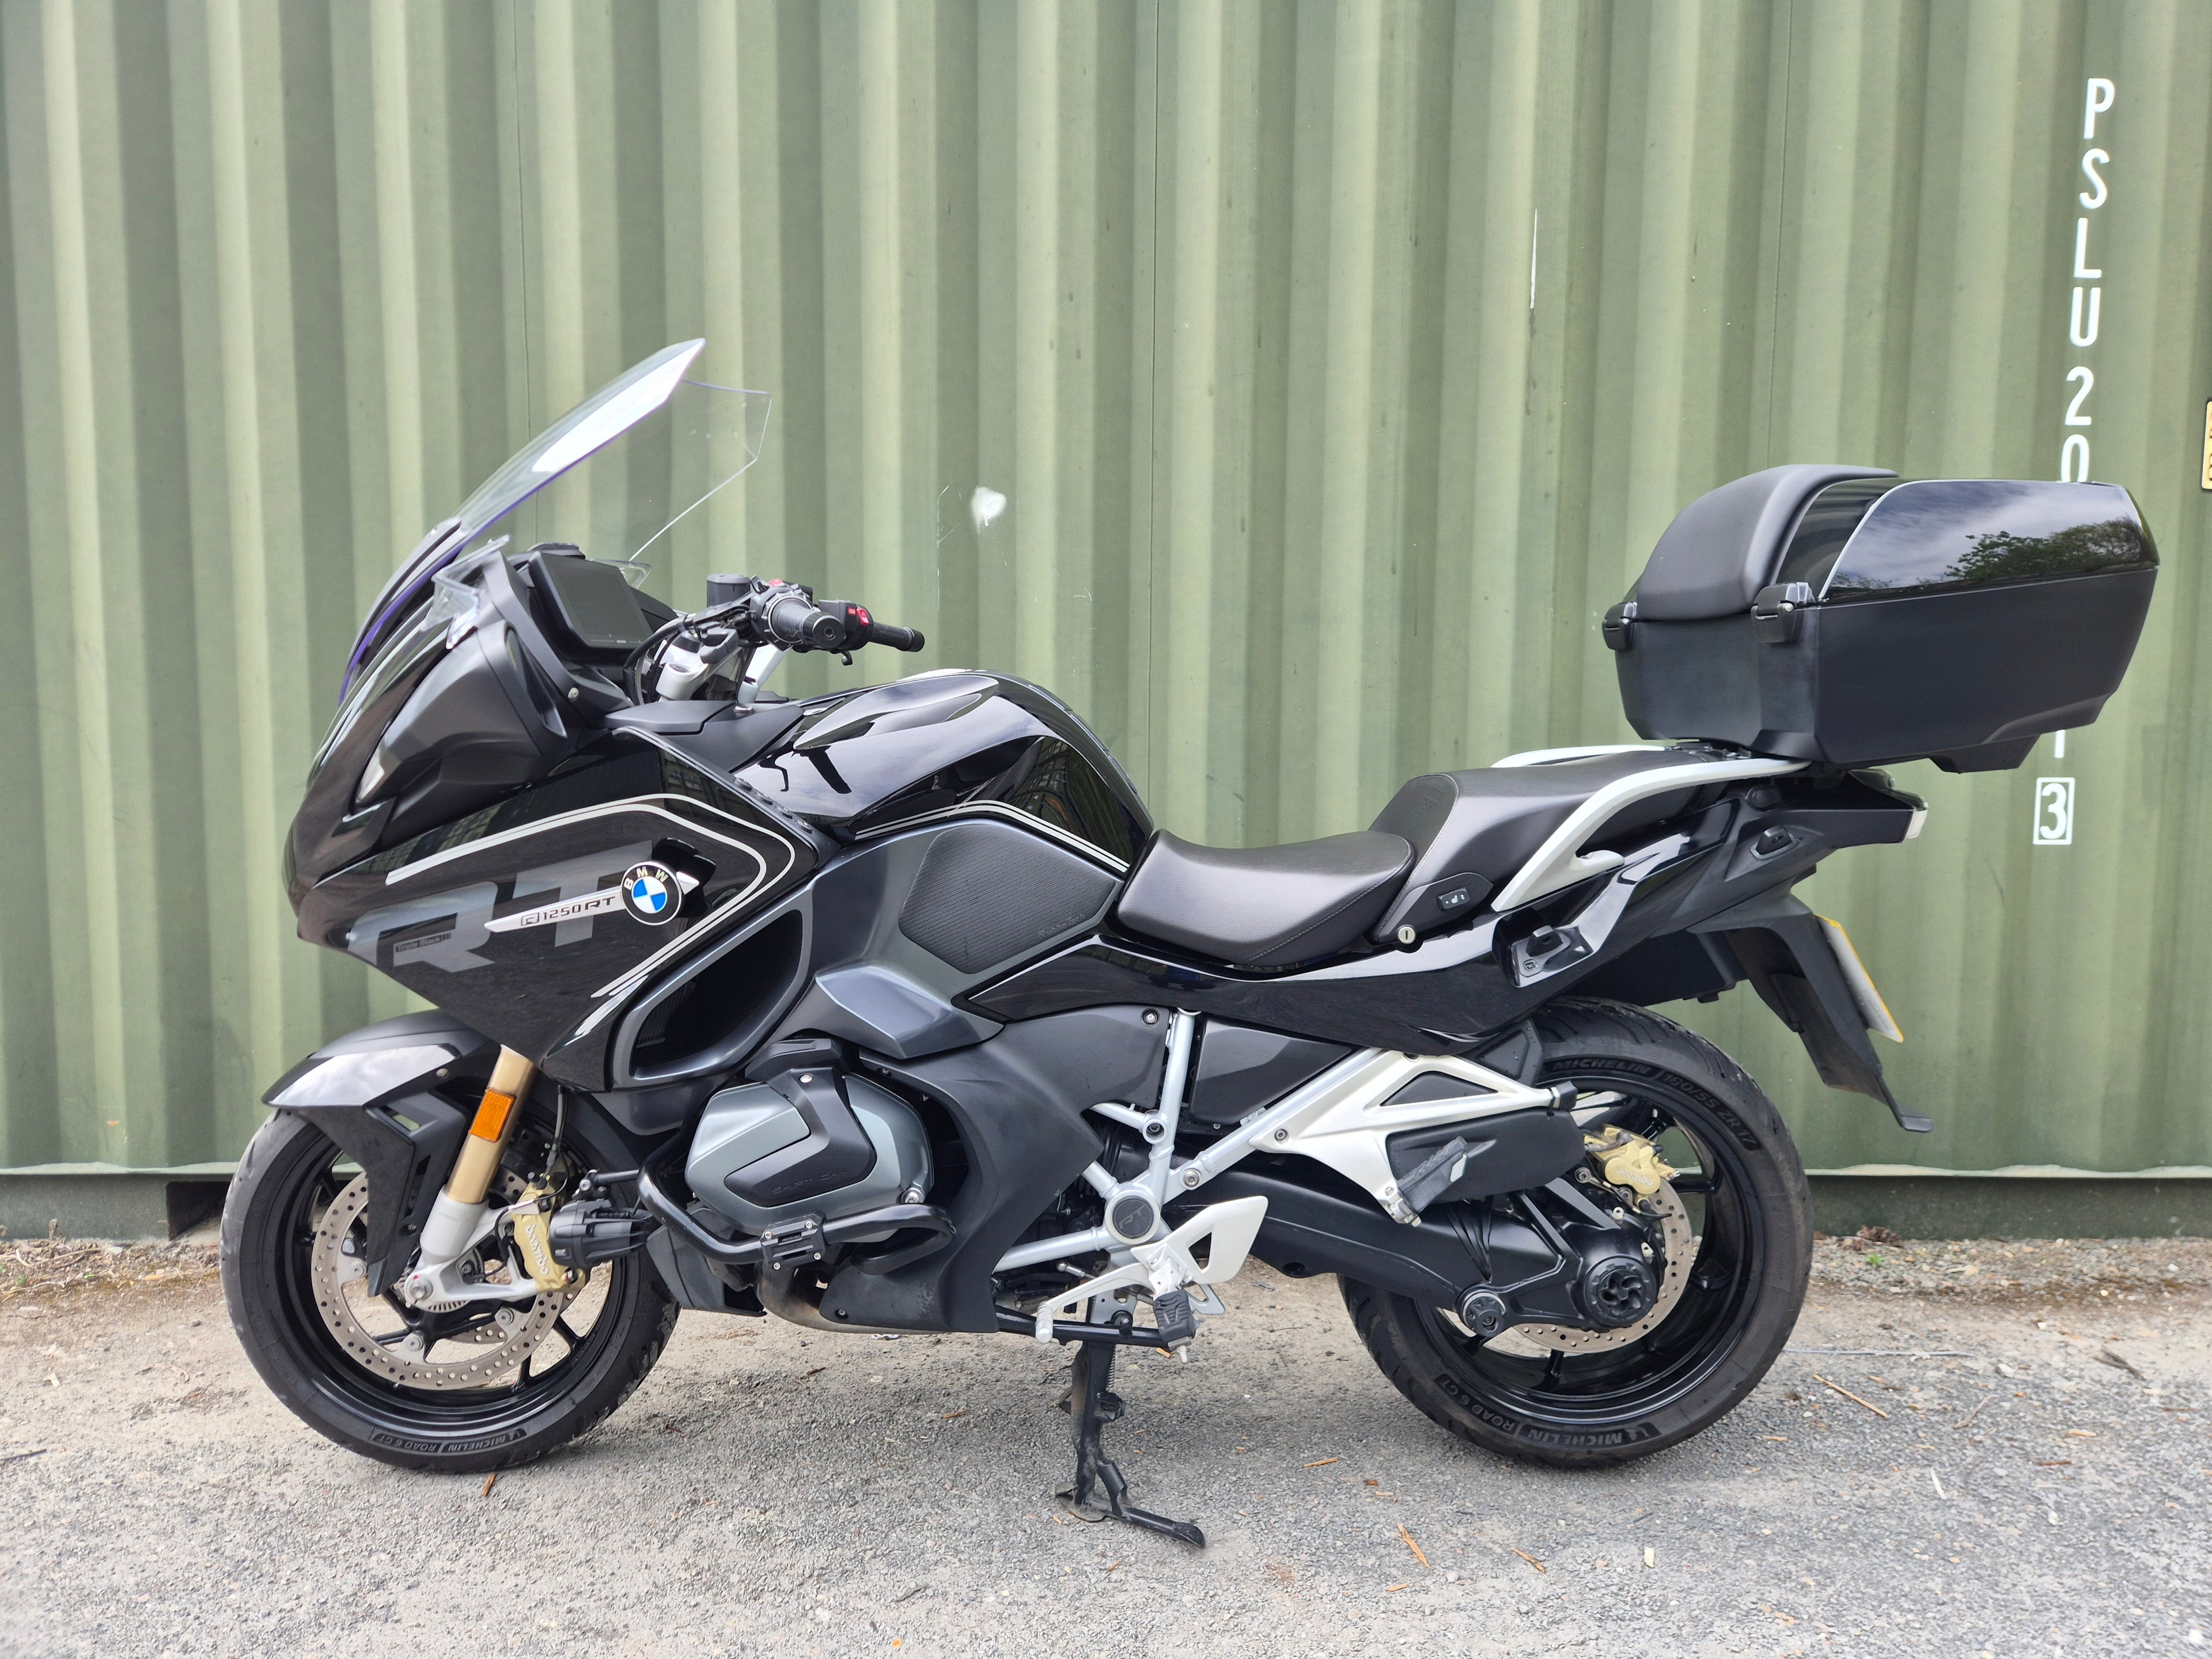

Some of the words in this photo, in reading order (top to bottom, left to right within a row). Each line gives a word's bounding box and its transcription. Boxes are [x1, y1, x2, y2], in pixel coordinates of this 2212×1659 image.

[2069, 77, 2116, 347] PSLU
[623, 865, 669, 891] BMW
[1552, 1058, 1653, 1075] MICHELIN
[1616, 1165, 1654, 1185] brembo
[771, 1178, 813, 1194] SHIFT
[1119, 1205, 1145, 1229] RT
[524, 1223, 550, 1275] brembo
[1472, 1404, 1517, 1433] ROAD
[404, 1441, 437, 1452] ROAD
[448, 1435, 506, 1452] MICHELIN
[1528, 1429, 1623, 1446] MICHELIN
